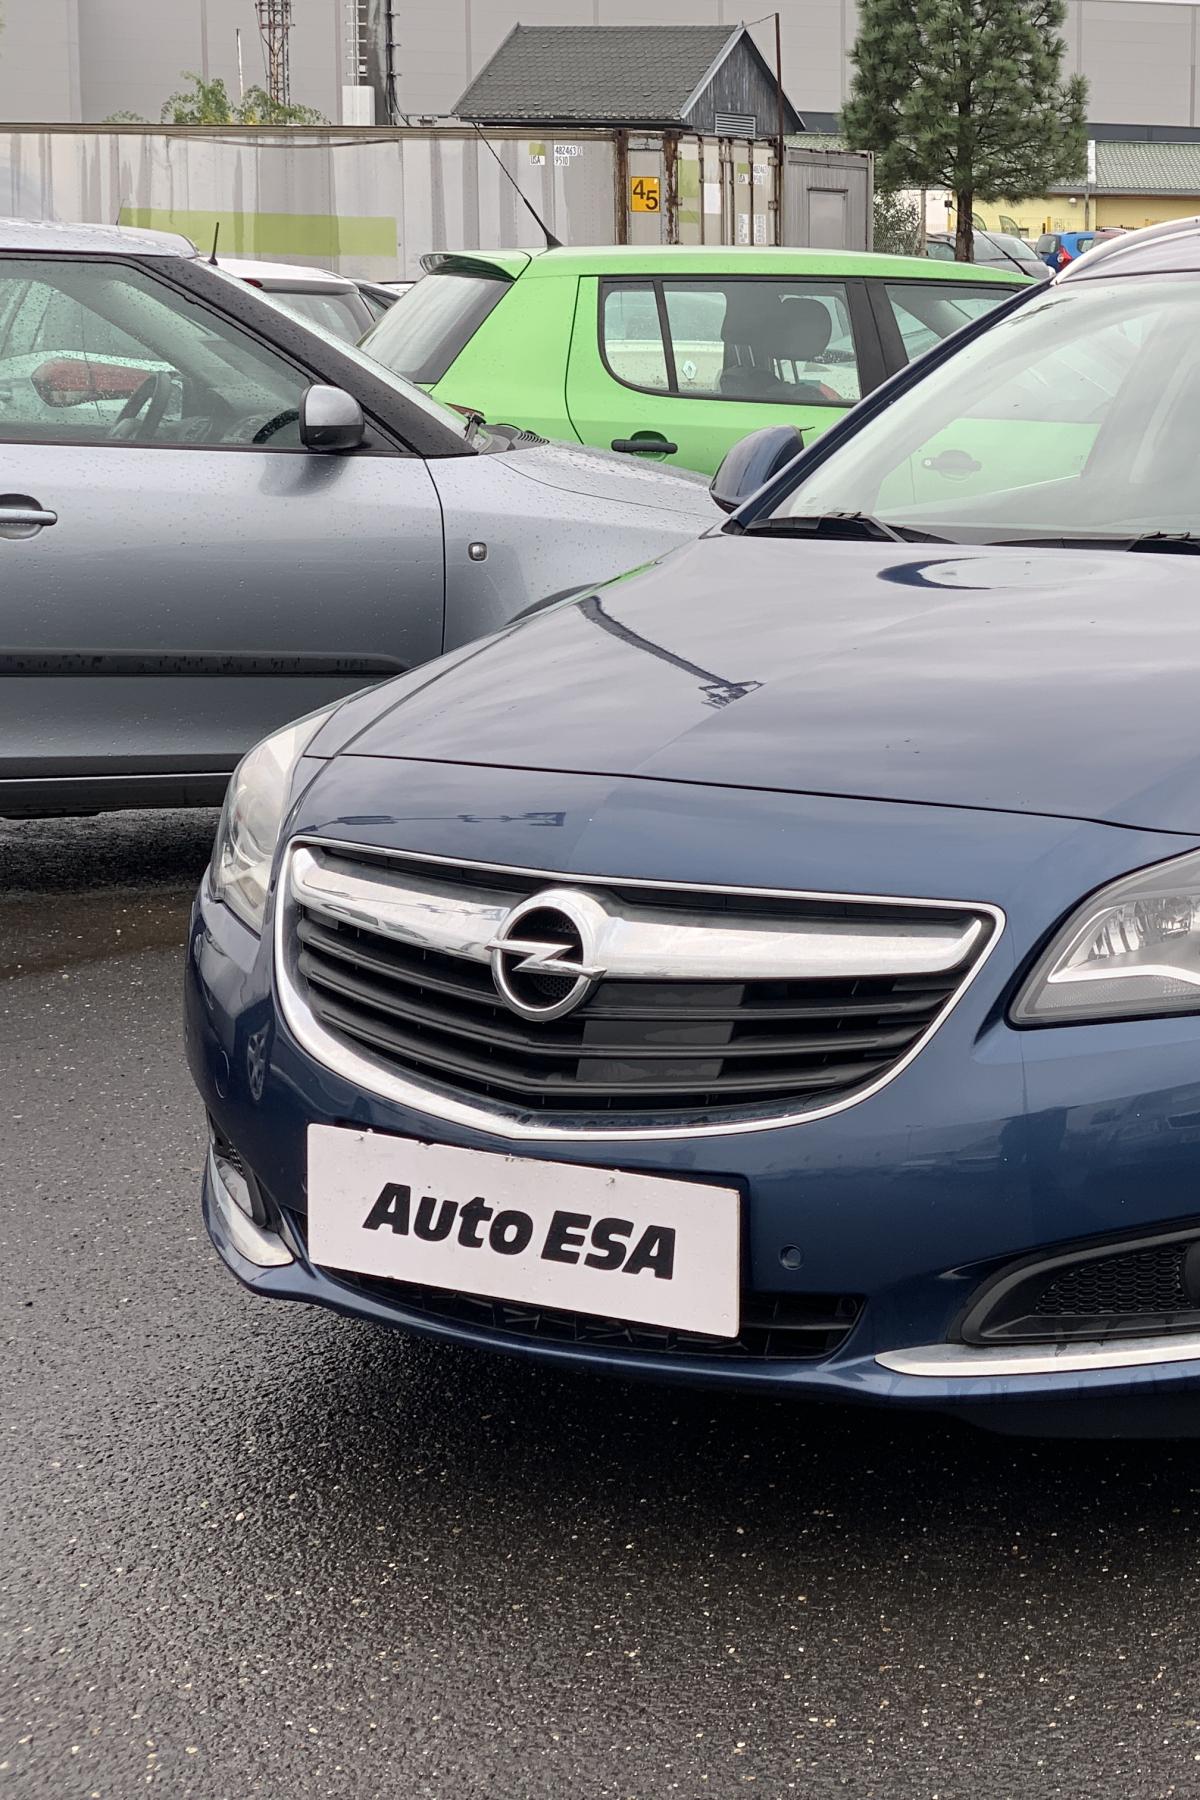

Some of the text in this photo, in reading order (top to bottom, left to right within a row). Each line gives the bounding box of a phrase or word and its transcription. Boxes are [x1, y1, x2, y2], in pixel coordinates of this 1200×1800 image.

[531, 156, 541, 165] USA
[362, 1182, 677, 1280] Auto ESA
